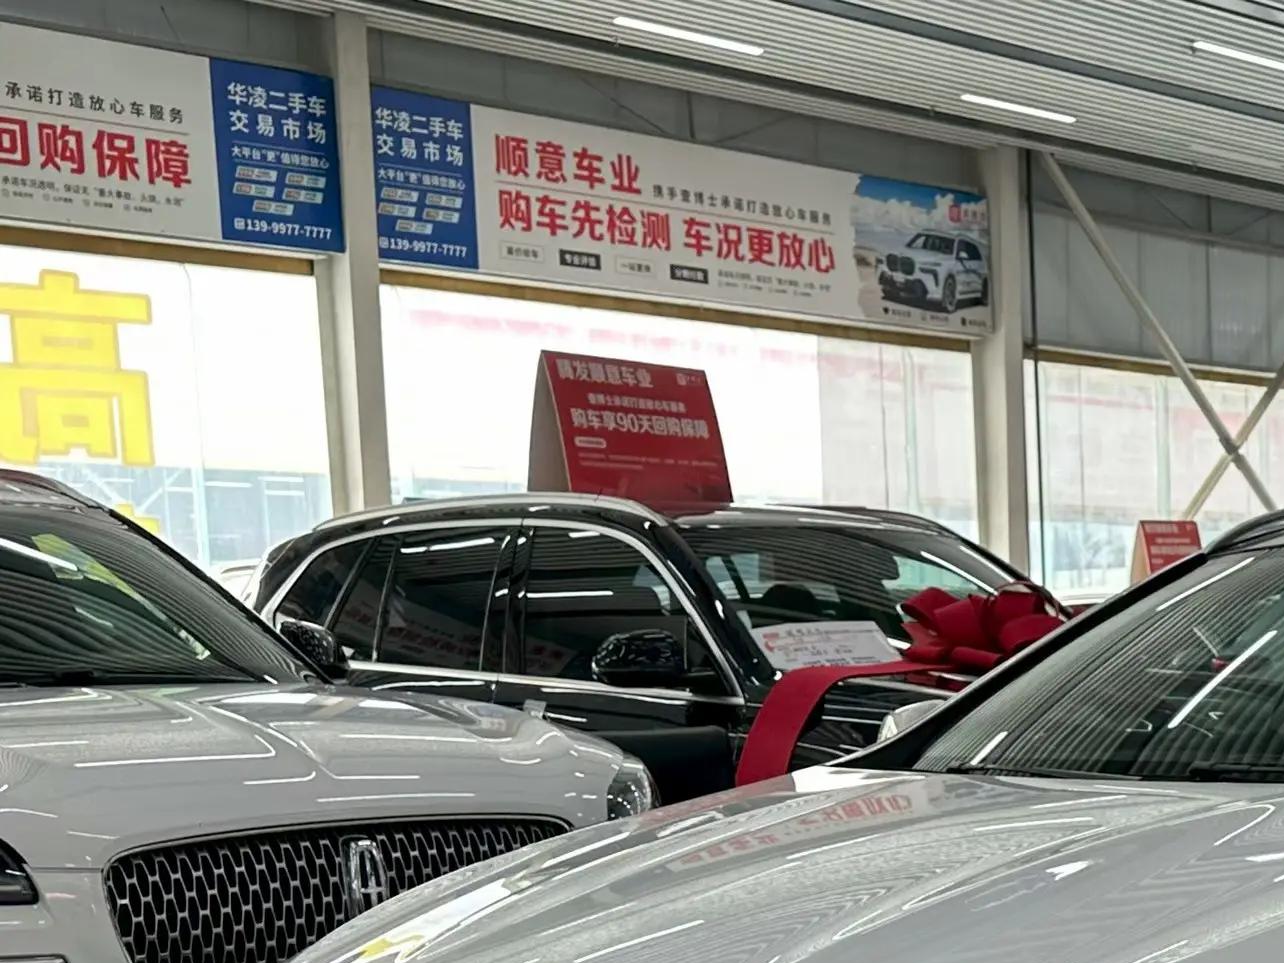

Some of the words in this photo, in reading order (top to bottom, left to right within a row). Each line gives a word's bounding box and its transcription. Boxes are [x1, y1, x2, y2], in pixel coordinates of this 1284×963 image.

[4, 80, 184, 125] 承诺打造放心车服务
[227, 81, 326, 117] 华凌二手车
[229, 109, 326, 145] 交易市场
[375, 106, 464, 140] 华凌二手车
[0, 116, 192, 189] 回购保障
[376, 133, 463, 166] 交易市场
[495, 133, 641, 195] 顺意车业
[246, 218, 332, 240] 139-9977-7777
[390, 236, 467, 258] 139-9977-7777
[498, 189, 671, 251] 购车先检测
[682, 217, 836, 273] 车况更放心
